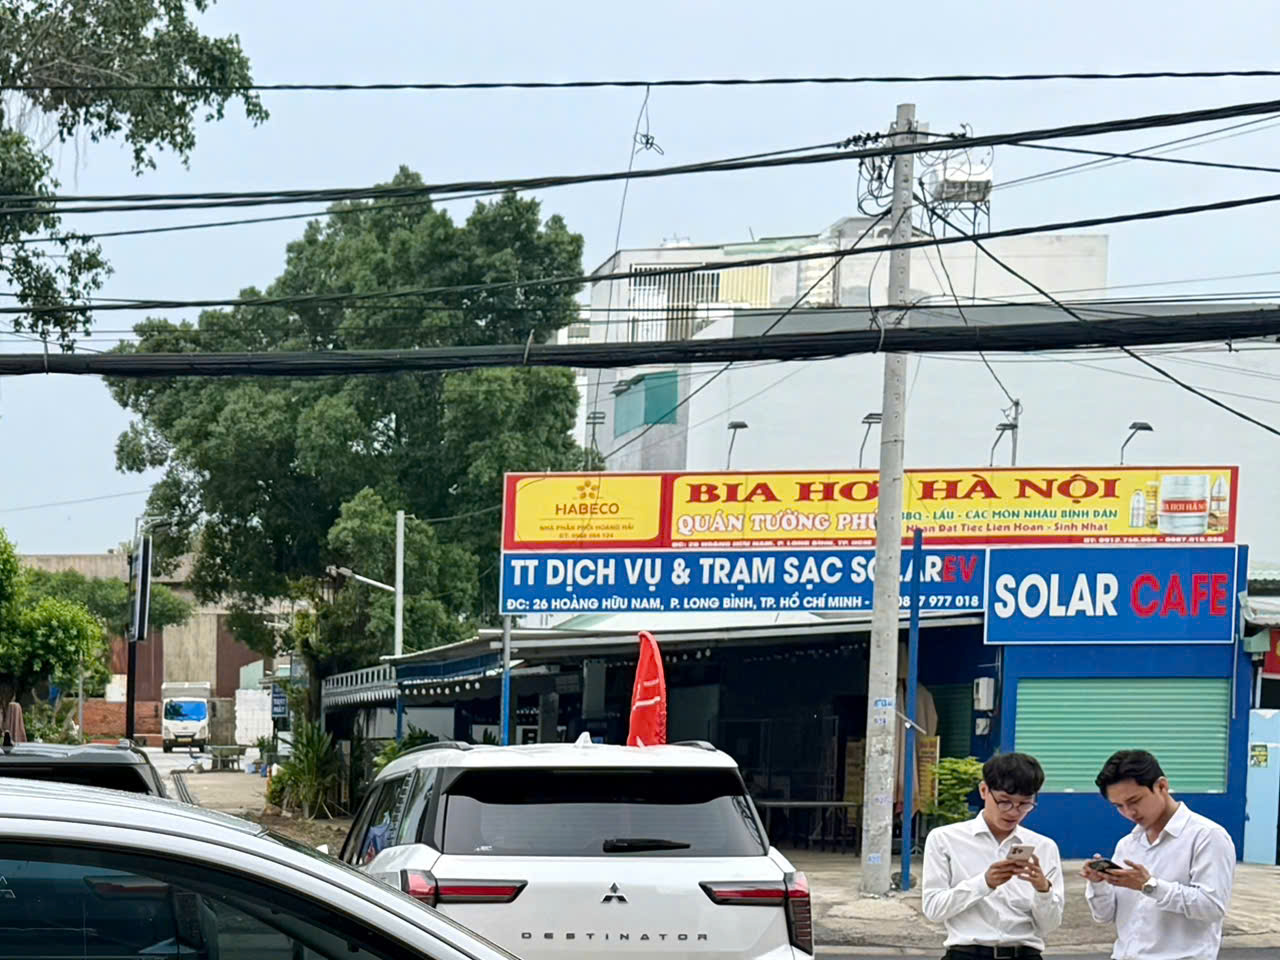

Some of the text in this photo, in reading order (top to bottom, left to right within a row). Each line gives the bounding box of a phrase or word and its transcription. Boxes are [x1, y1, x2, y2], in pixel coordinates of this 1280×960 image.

[686, 474, 1120, 504] BIA HƠ HÀ NỘI
[555, 503, 620, 515] HABECO
[678, 510, 744, 535] QUÁN
[751, 508, 831, 531] TƯỜNG
[1054, 522, 1078, 531] Sinh
[511, 559, 539, 586] TT
[546, 557, 615, 592] DỊCH
[624, 557, 662, 592] VỤ
[671, 557, 691, 585] &
[699, 556, 775, 591] TRẠM
[783, 555, 843, 590] SẠC
[506, 598, 530, 610] ĐC:
[533, 598, 548, 610] 26
[552, 594, 598, 610] HOÀNG
[602, 595, 628, 609] HỮU
[631, 598, 665, 611] NAM,
[670, 597, 680, 608] P.
[683, 597, 720, 609] LONG
[723, 593, 757, 610] BÌNH,
[760, 596, 777, 608] TP.
[779, 592, 800, 609] HỒ
[803, 592, 826, 608] CHÍ
[828, 596, 862, 608] MINH
[929, 595, 953, 607] 977
[956, 595, 979, 607] 018
[994, 572, 1230, 618] SOLAR CAFE
[521, 932, 709, 941] DESTINATOR
